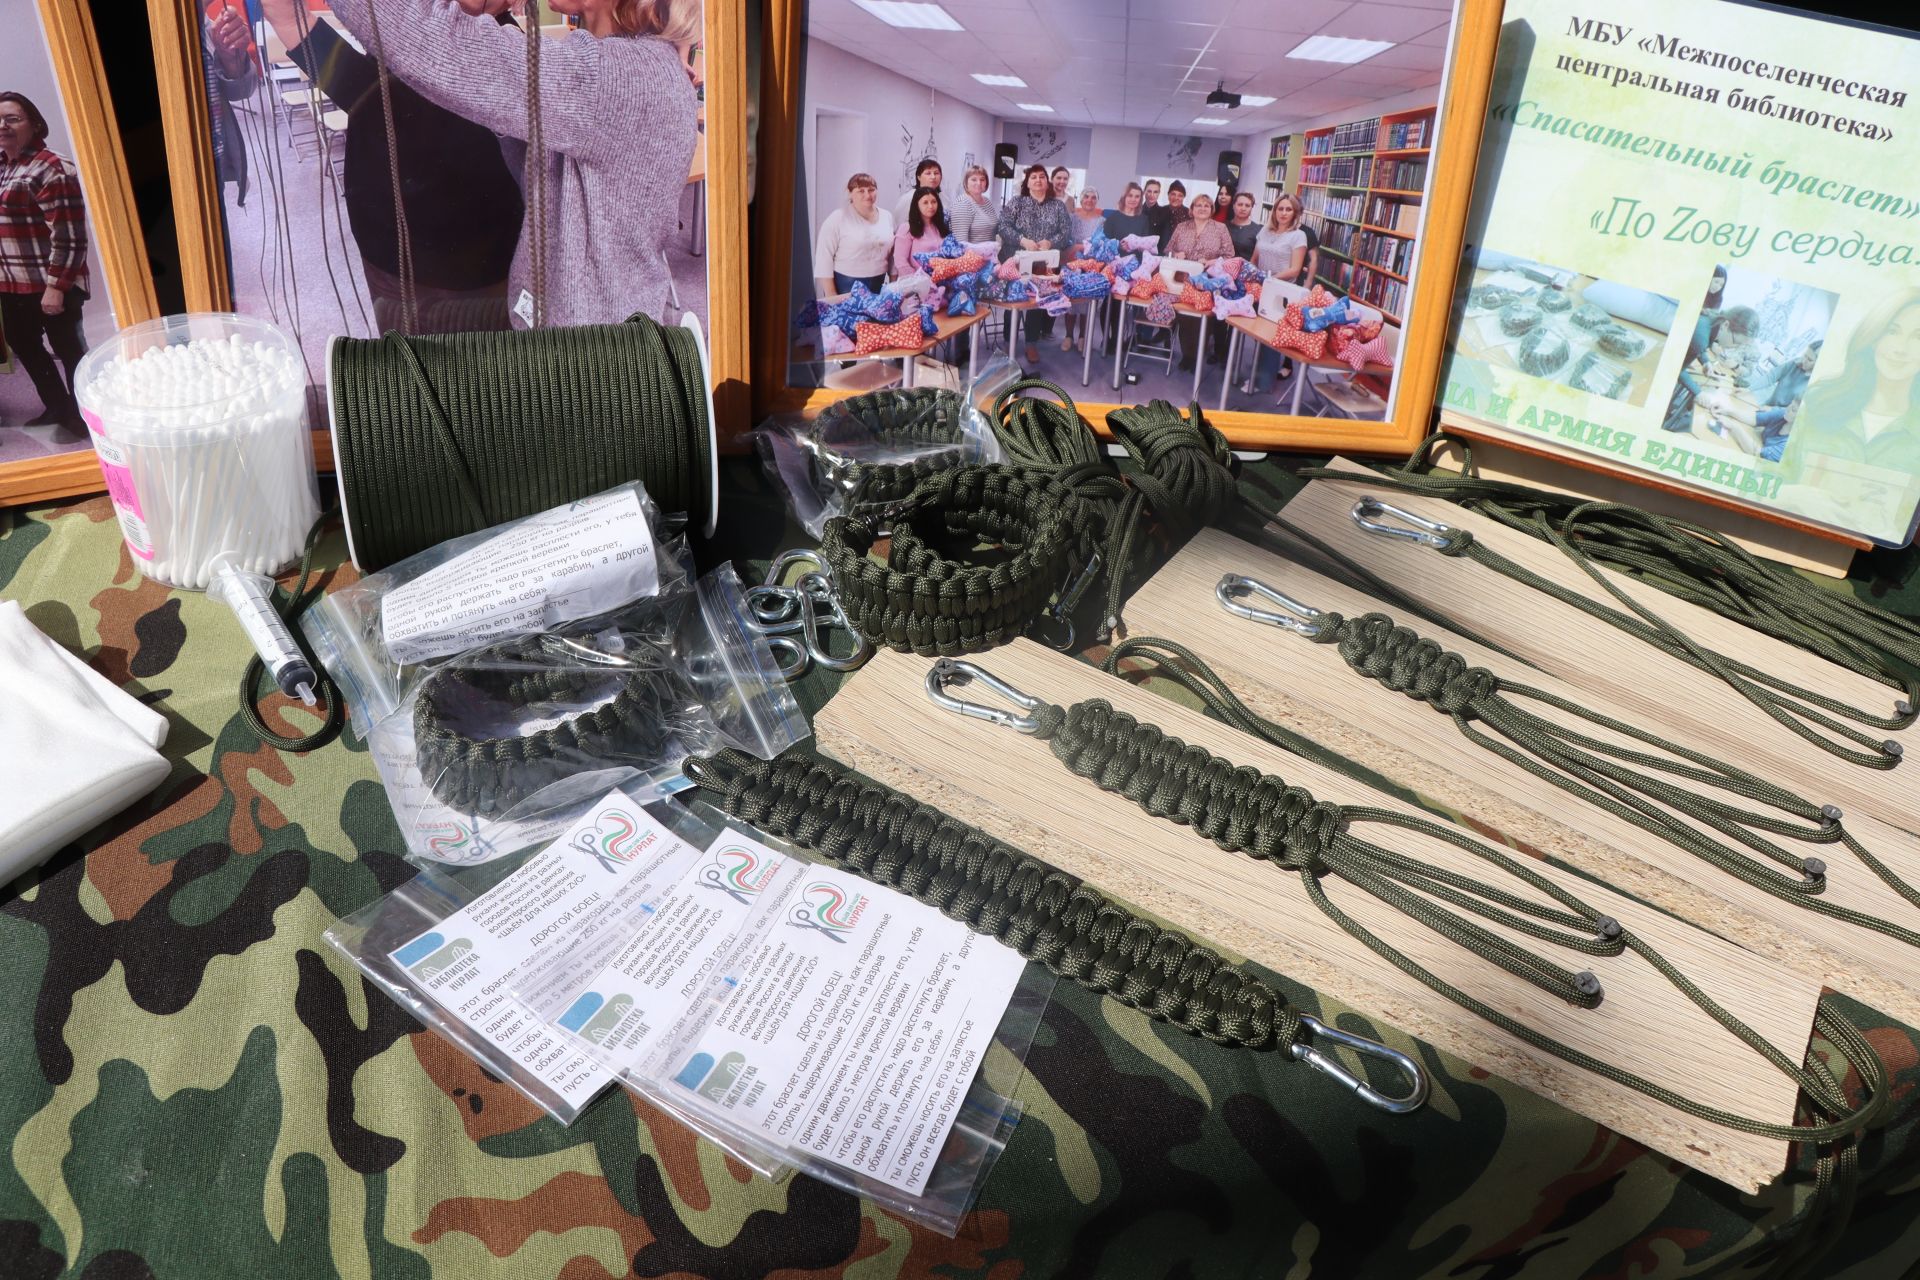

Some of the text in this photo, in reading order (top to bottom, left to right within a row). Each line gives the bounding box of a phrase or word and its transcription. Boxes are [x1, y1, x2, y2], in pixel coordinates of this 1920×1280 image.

[1565, 15, 1908, 109] МБУ «Межпоселенческая
[1555, 53, 1894, 144] центральная библиотека»
[1492, 99, 1920, 219] «Спасательный браслет»
[1590, 197, 1920, 267] «По Zову сердца
[1485, 394, 1513, 420] И
[1516, 405, 1637, 457] АРМИЯ
[1641, 439, 1784, 499] ЕДИНЫ!
[626, 832, 658, 860] НУРЛАТ
[530, 891, 601, 947] ДОРОГОЙ БОЕЦ!
[847, 895, 870, 926] НУРЛАТ
[428, 953, 480, 990] БИБЛИОТЕКА
[448, 966, 481, 991] НУРЛАТ
[458, 995, 480, 1013] этот
[481, 967, 519, 996] браслет
[796, 970, 843, 1042] ДОРОГОЙ БОЕЦ!
[485, 1009, 517, 1034] одним
[495, 1019, 524, 1042] будет
[512, 1030, 543, 1053] чтобы
[523, 1038, 554, 1063] одной
[602, 1008, 645, 1051] БИБЛИОТЕКА
[761, 913, 892, 1130] этот браслет сделан из паракорда, как парашютные
[777, 954, 885, 1136] стропы, выдерживающие 250 кг на разрыв
[799, 1115, 821, 1145] одним
[816, 1064, 850, 1116] движением
[844, 1050, 858, 1062] ты
[852, 1015, 877, 1050] можешь
[872, 971, 901, 1015] расплести
[896, 955, 912, 970] его,
[908, 926, 924, 945] тебя
[836, 952, 953, 1159] чтобы его распустить, надо расстегнуть браслет,
[852, 1135, 873, 1166] одной
[871, 1102, 891, 1131] рукой
[889, 1059, 914, 1098] держать
[911, 1037, 925, 1053] его
[921, 1020, 933, 1032] за
[930, 978, 956, 1014] карабин,
[958, 929, 977, 960] другой
[550, 1071, 566, 1084] ты
[562, 1072, 591, 1093] пусть
[812, 982, 911, 1151] будет около 5 метров крепкой веревки
[867, 1029, 944, 1172] обхватить и потянуть «на себя»
[889, 1020, 974, 1181] ты сможешь носить его на запястье
[905, 1161, 925, 1188] пусть
[919, 1145, 932, 1159] он
[926, 1113, 947, 1145] всегда
[940, 1084, 960, 1112] будет
[958, 1049, 977, 1076] тобой
